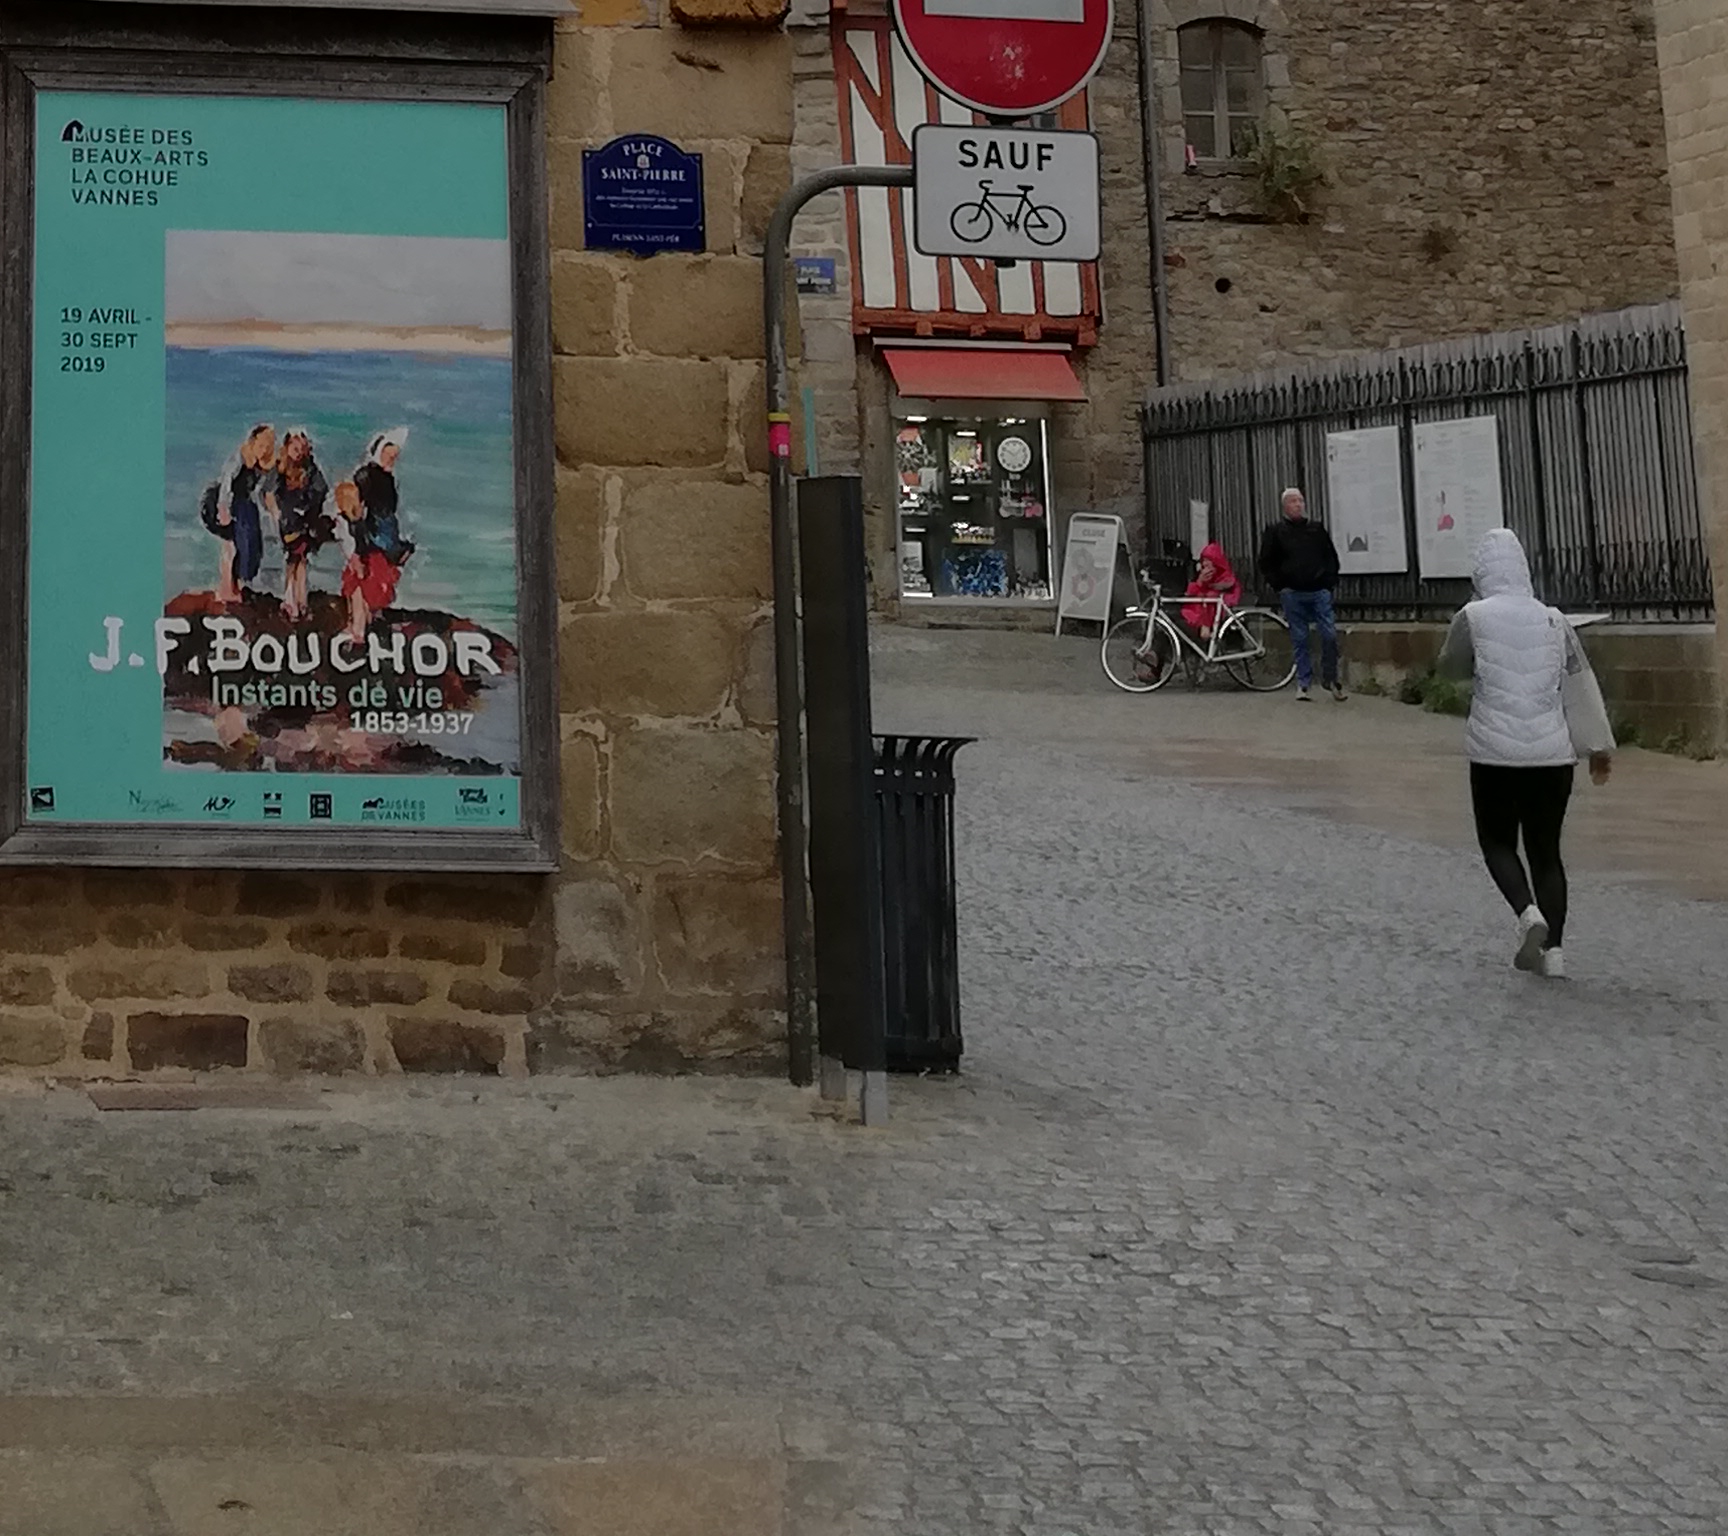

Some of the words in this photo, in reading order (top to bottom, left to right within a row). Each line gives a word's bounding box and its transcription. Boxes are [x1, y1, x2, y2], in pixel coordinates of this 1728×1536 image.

[152, 129, 193, 145] DES
[71, 148, 209, 166] BEAUX-ARTS
[622, 142, 664, 157] PLACE
[957, 139, 1055, 172] SAUF
[71, 168, 98, 184] LA
[103, 169, 178, 186] COHUE
[600, 167, 687, 182] SAINT-PIERRE
[71, 188, 159, 206] VANNES
[60, 307, 83, 324] 19
[88, 308, 141, 325] AVRIL
[60, 332, 84, 349] 30
[90, 333, 138, 349] SEPT
[60, 357, 105, 373] 2019
[212, 675, 338, 709] Instants
[349, 677, 387, 708] de
[398, 678, 443, 709] vie
[349, 711, 475, 735] 1853-1937
[377, 811, 426, 821] VANNES
